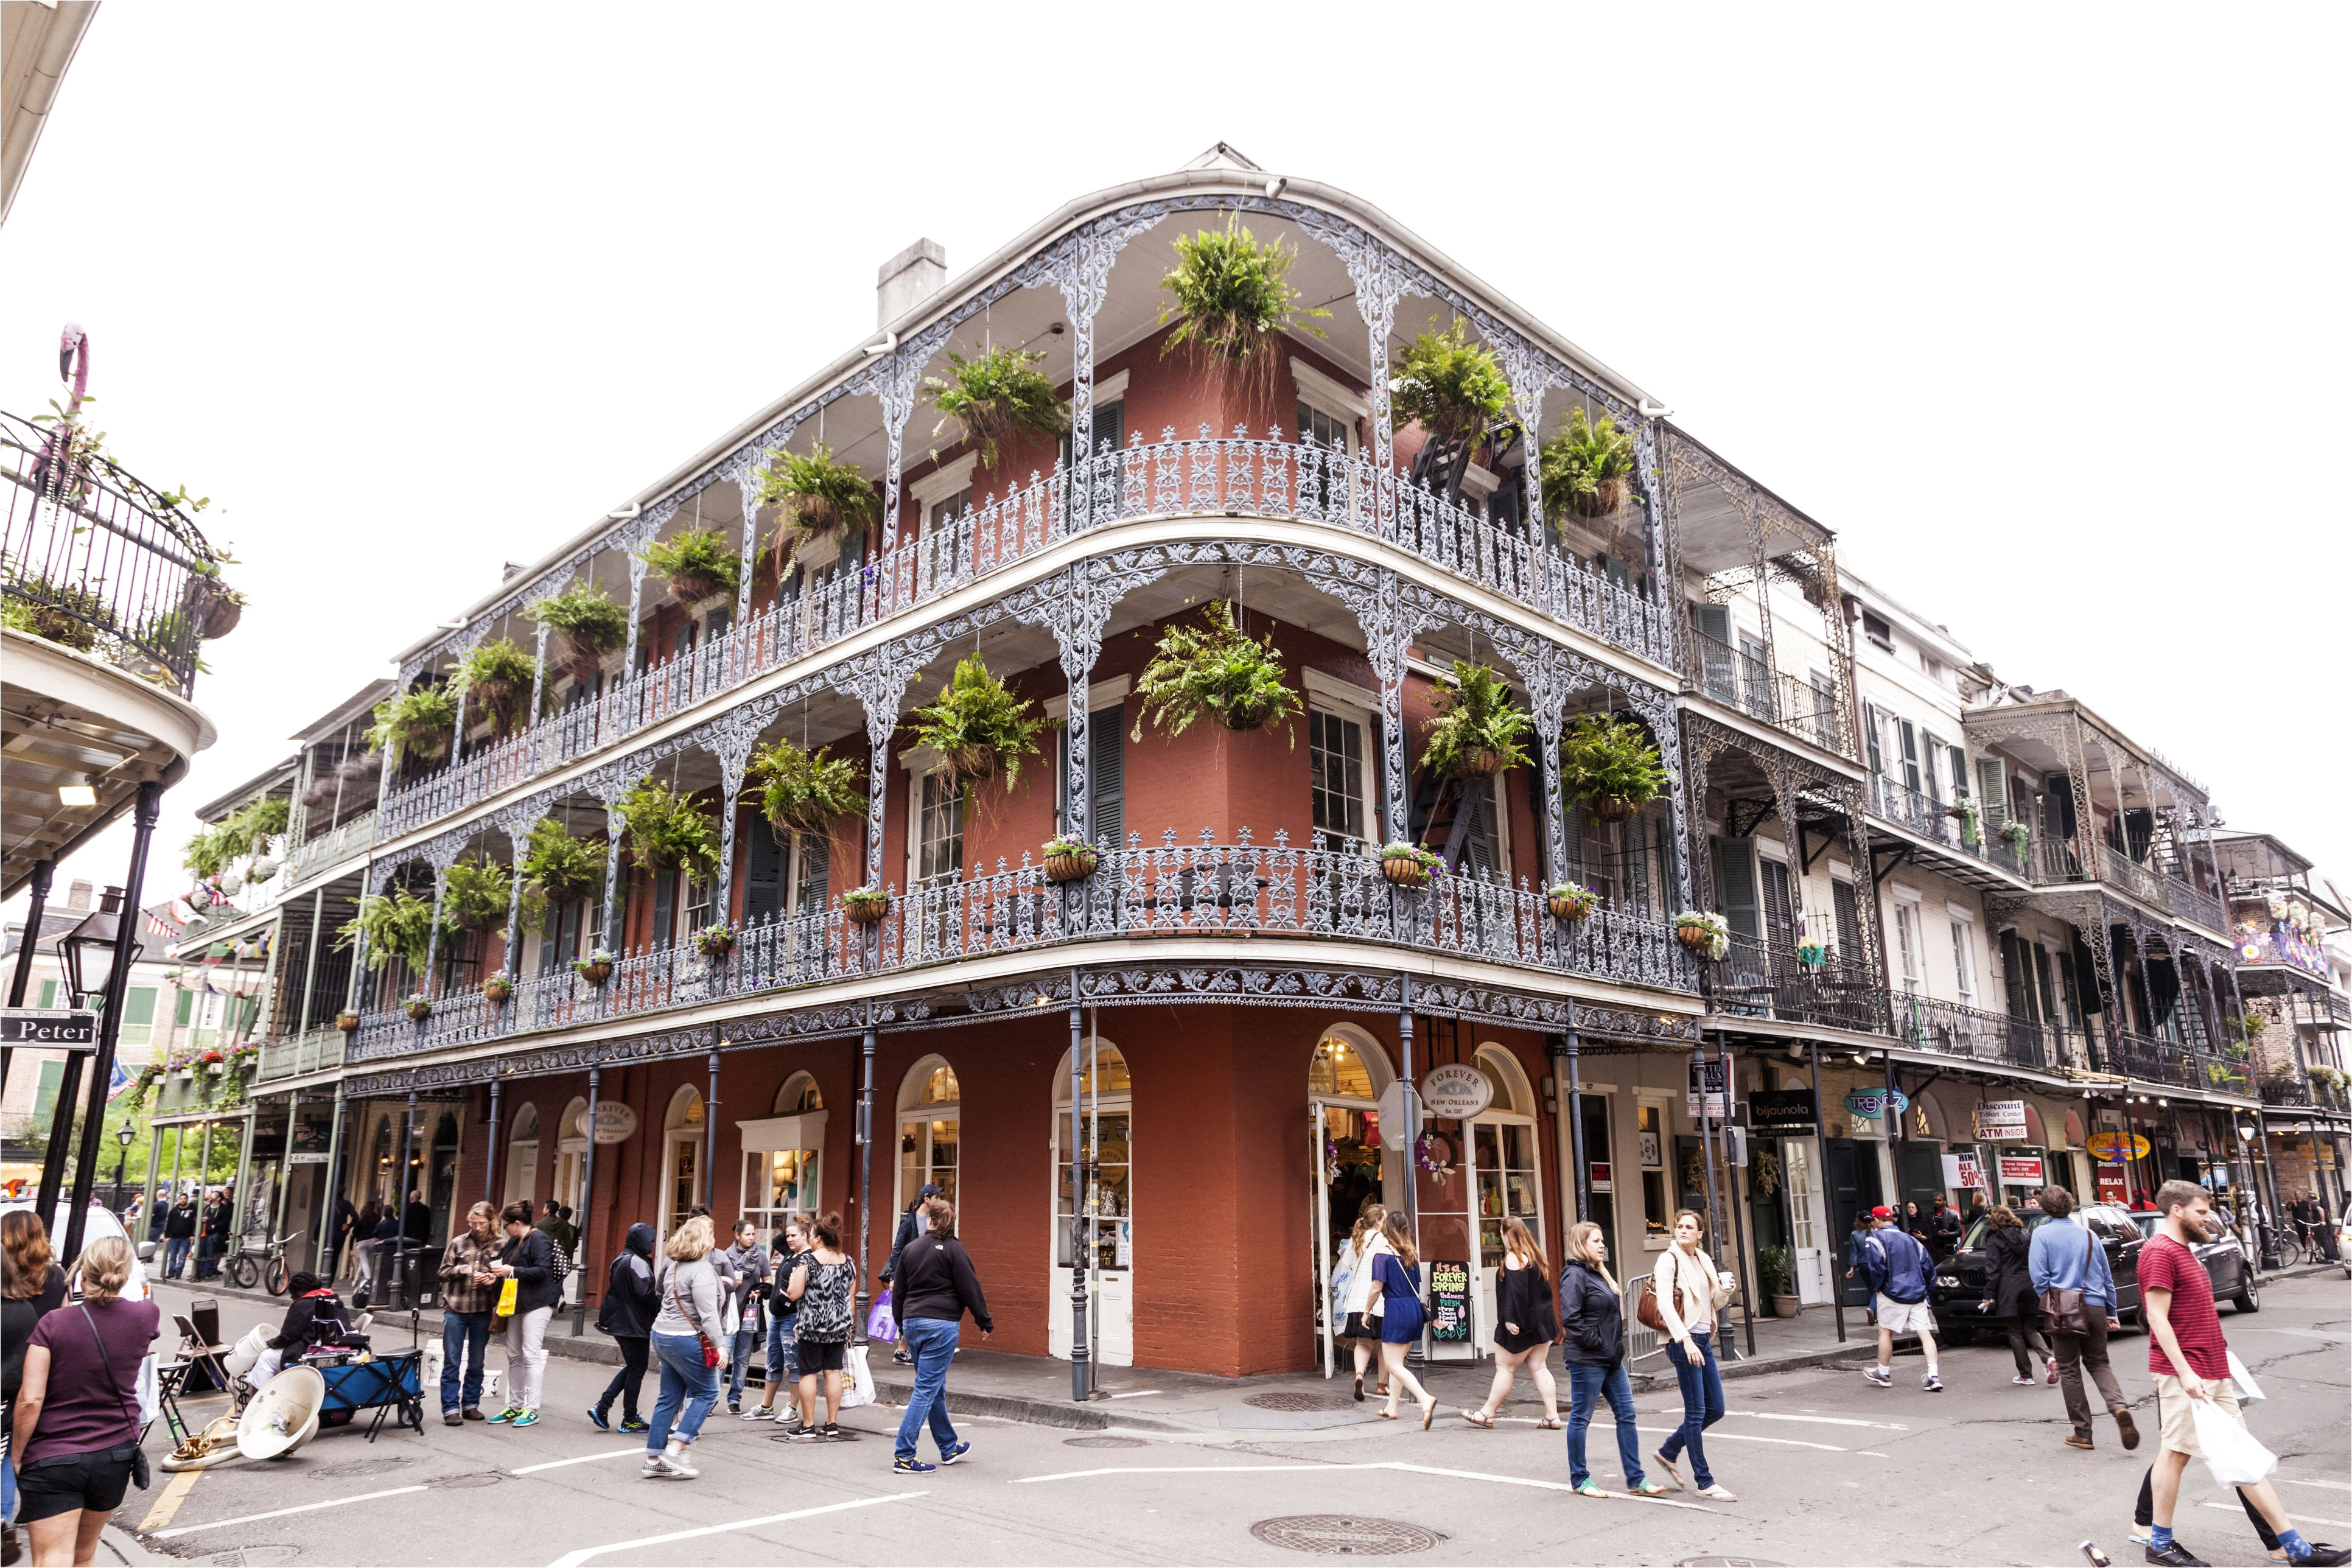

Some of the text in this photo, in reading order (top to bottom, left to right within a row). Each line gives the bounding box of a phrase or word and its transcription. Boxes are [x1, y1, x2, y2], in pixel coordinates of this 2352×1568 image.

[18, 1021, 89, 1039] Peter
[1430, 1069, 1479, 1088] FOREVER
[596, 1105, 629, 1119] OREVER
[1756, 1103, 1808, 1118] bijounola
[1979, 1128, 2025, 1138] ATM INSIDE
[2119, 1134, 2146, 1147] DRAMS
[1961, 1171, 1984, 1186] 50%
[1437, 1262, 1461, 1273] it's a
[1433, 1272, 1467, 1283] FOREVER
[1432, 1282, 1465, 1292] SPRING
